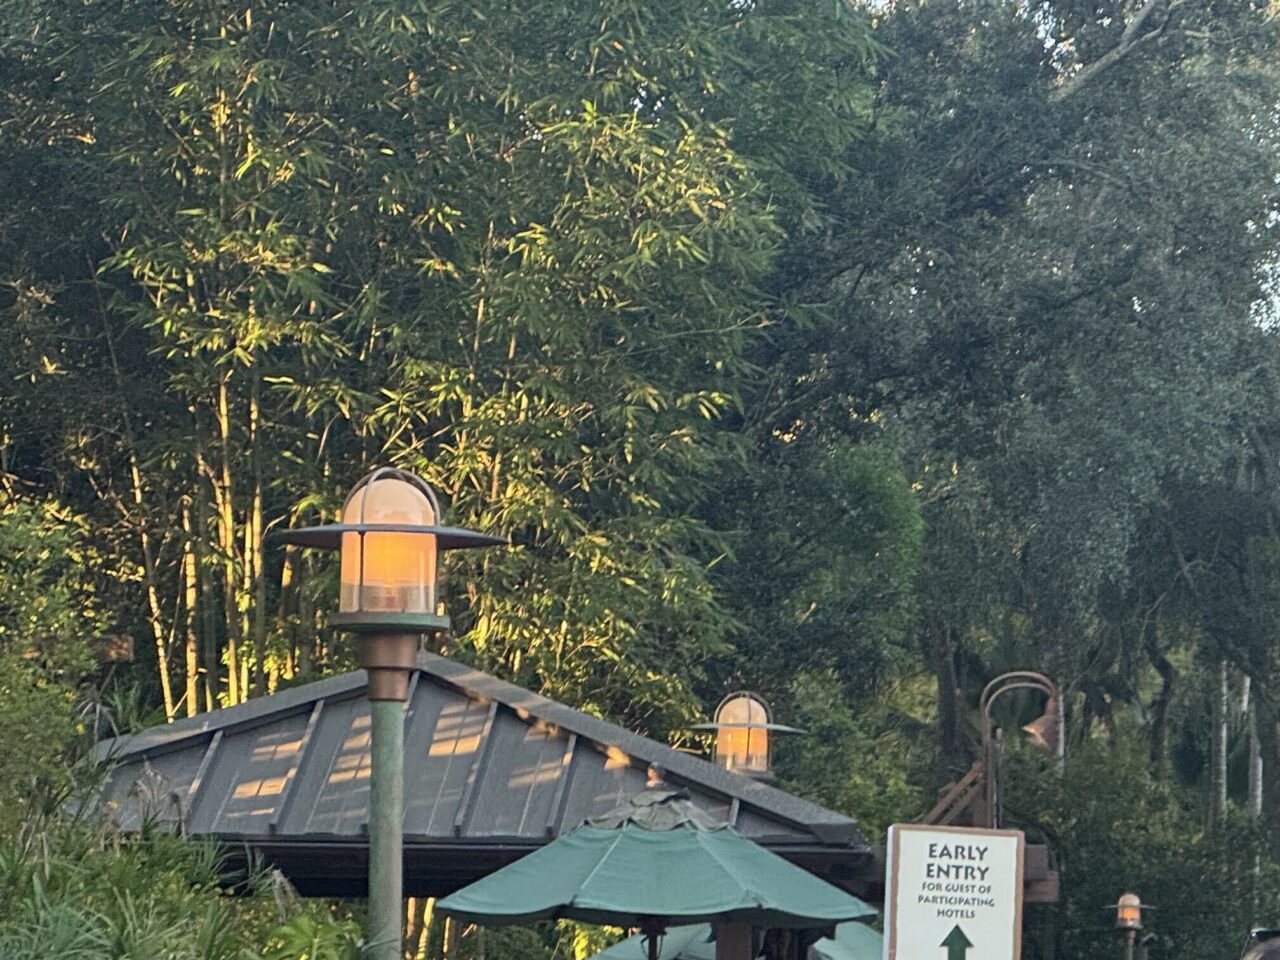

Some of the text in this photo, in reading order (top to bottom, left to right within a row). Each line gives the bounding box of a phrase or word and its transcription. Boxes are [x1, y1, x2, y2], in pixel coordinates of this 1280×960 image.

[928, 843, 989, 861] EARLY
[926, 863, 990, 881] ENTRY
[922, 882, 992, 894] FOR GUEST OF
[917, 895, 995, 907] PARTICIPATING
[936, 908, 976, 919] HOTELS
